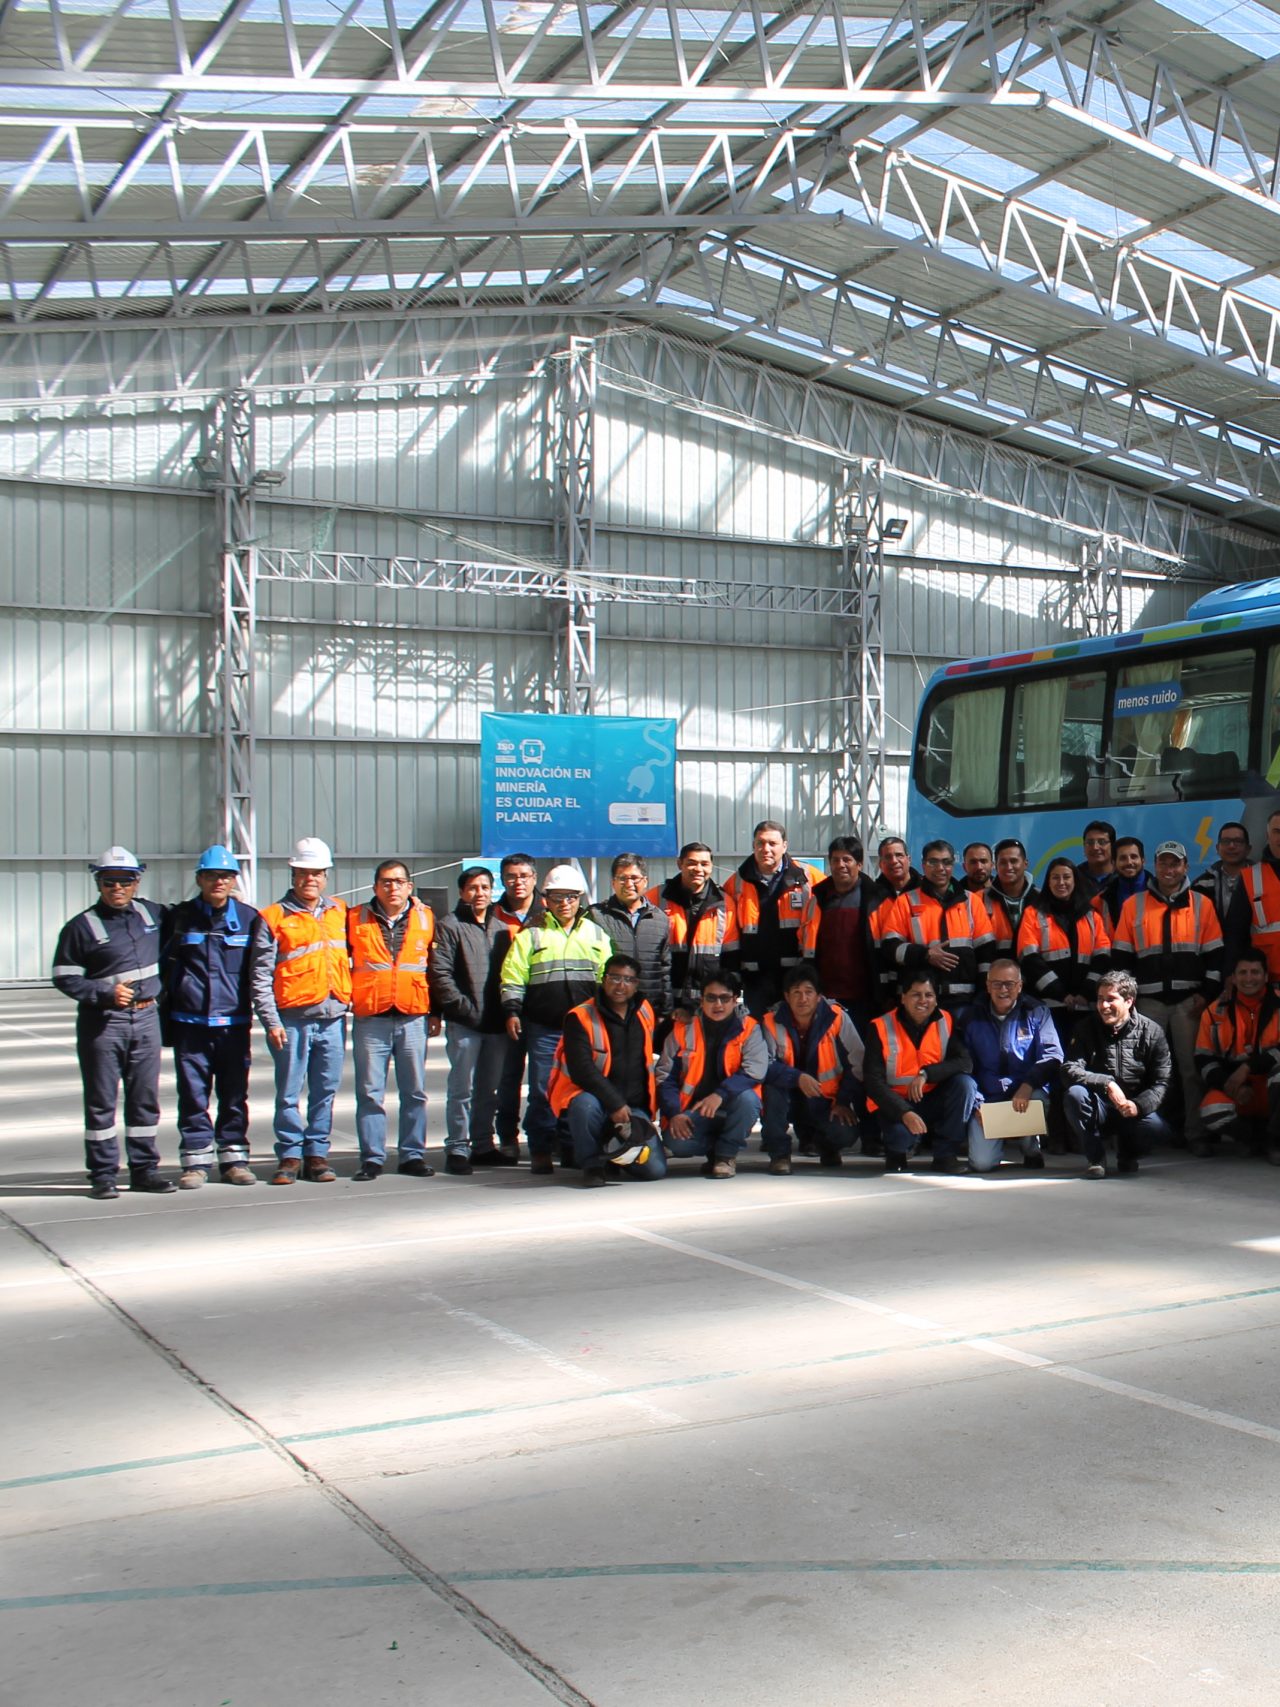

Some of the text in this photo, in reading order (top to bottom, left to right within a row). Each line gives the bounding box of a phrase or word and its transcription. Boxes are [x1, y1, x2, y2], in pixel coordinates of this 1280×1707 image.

[1117, 689, 1177, 709] menos ruido
[495, 765, 592, 779] INNOVACIÓN EN
[495, 780, 547, 793] MINERÍA
[495, 797, 581, 809] ES CUIDAR EL
[496, 811, 553, 823] PLANETA
